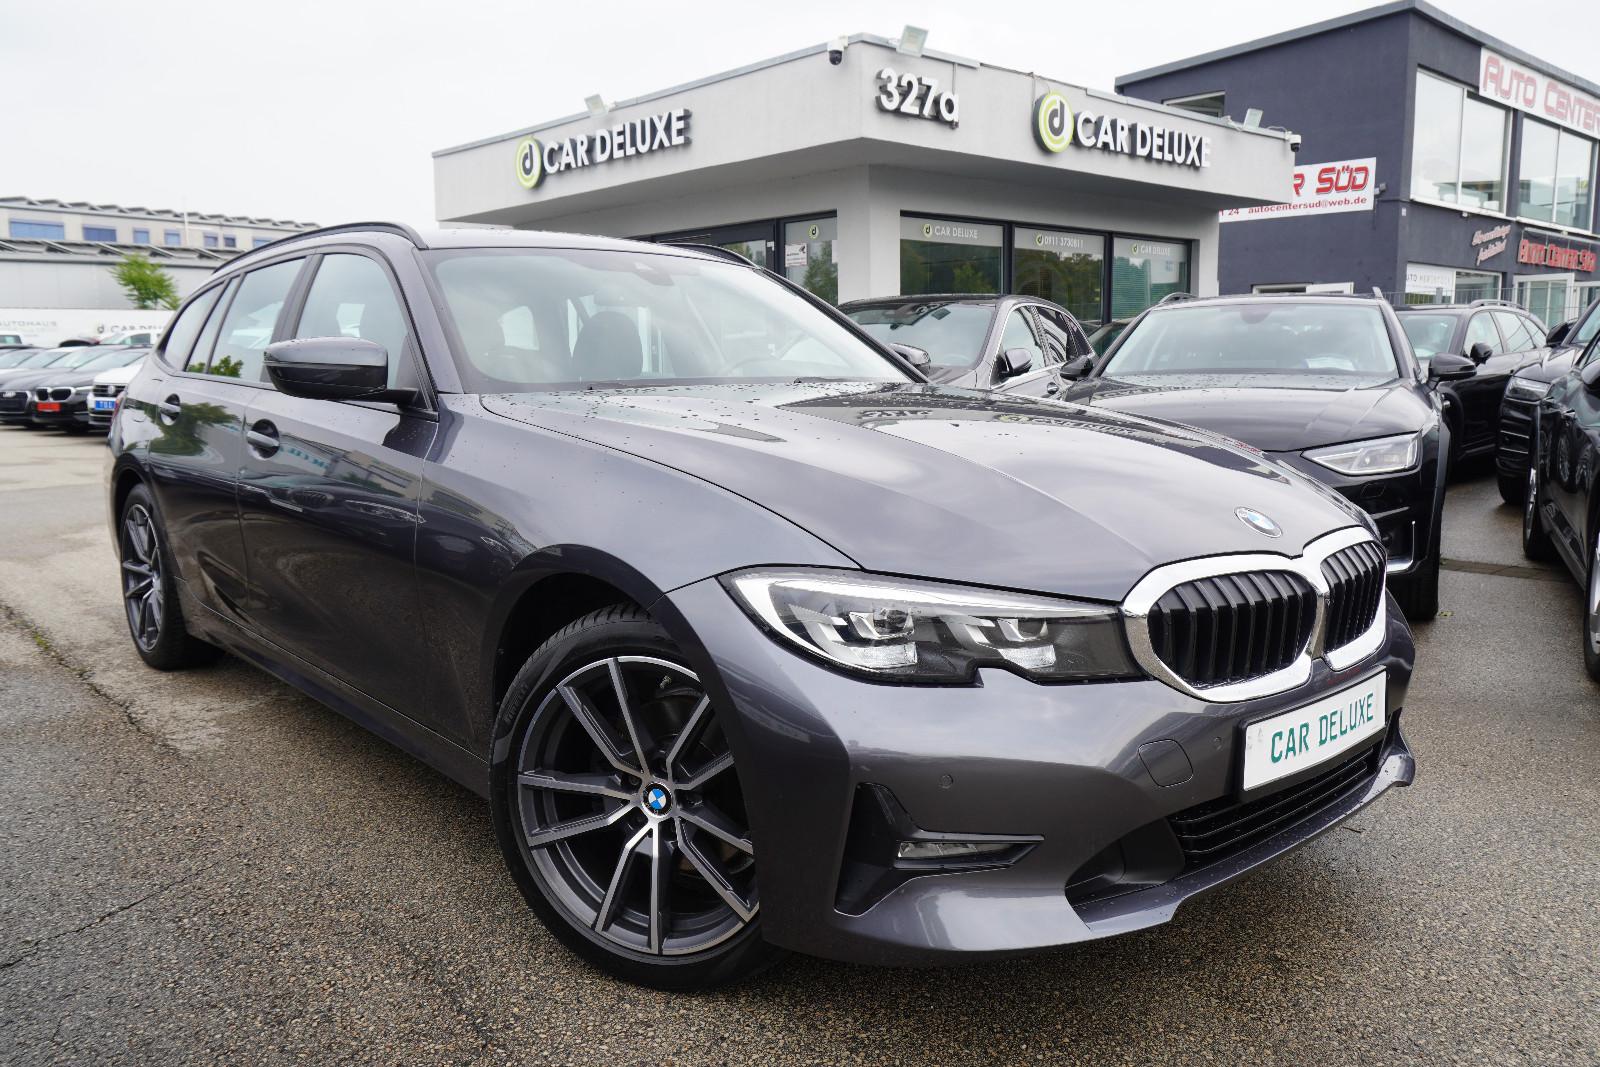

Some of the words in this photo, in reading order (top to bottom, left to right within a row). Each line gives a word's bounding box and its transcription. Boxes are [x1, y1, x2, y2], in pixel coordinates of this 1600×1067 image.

[877, 67, 959, 123] 327a
[1483, 55, 1537, 108] AUTO
[543, 134, 590, 174] CAR
[595, 108, 688, 163] DELUXE
[1076, 111, 1130, 154] CAR
[1135, 122, 1211, 168] DELUXE
[1316, 165, 1370, 195] SÜD
[935, 226, 951, 236] CAR
[953, 227, 978, 239] DELUXE
[1270, 722, 1309, 764] CAR
[1319, 692, 1374, 746] DELUXE
